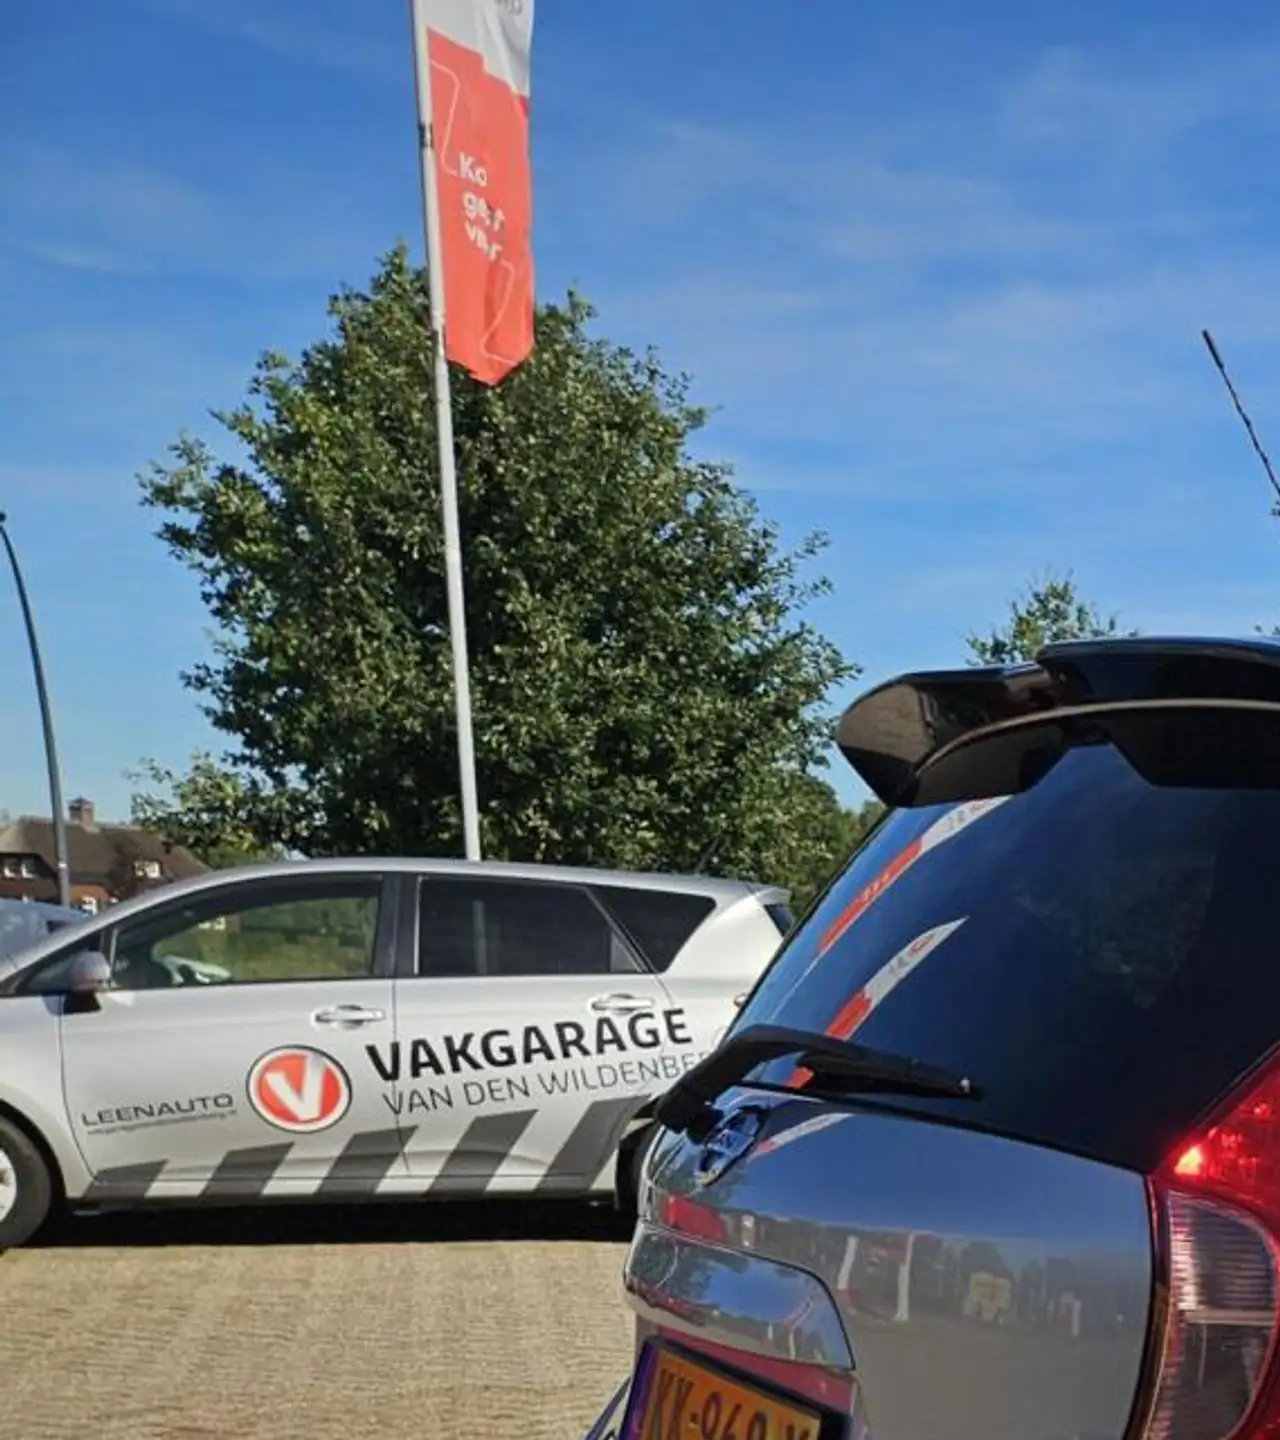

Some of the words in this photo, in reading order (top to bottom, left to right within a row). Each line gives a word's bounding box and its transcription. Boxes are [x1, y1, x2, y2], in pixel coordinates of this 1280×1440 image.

[365, 1008, 693, 1082] VAKGARAGE
[81, 1093, 234, 1127] LEENAUTO
[382, 1086, 454, 1115] VAN
[462, 1076, 530, 1106] DEN
[538, 1050, 710, 1096] WILDENBE
